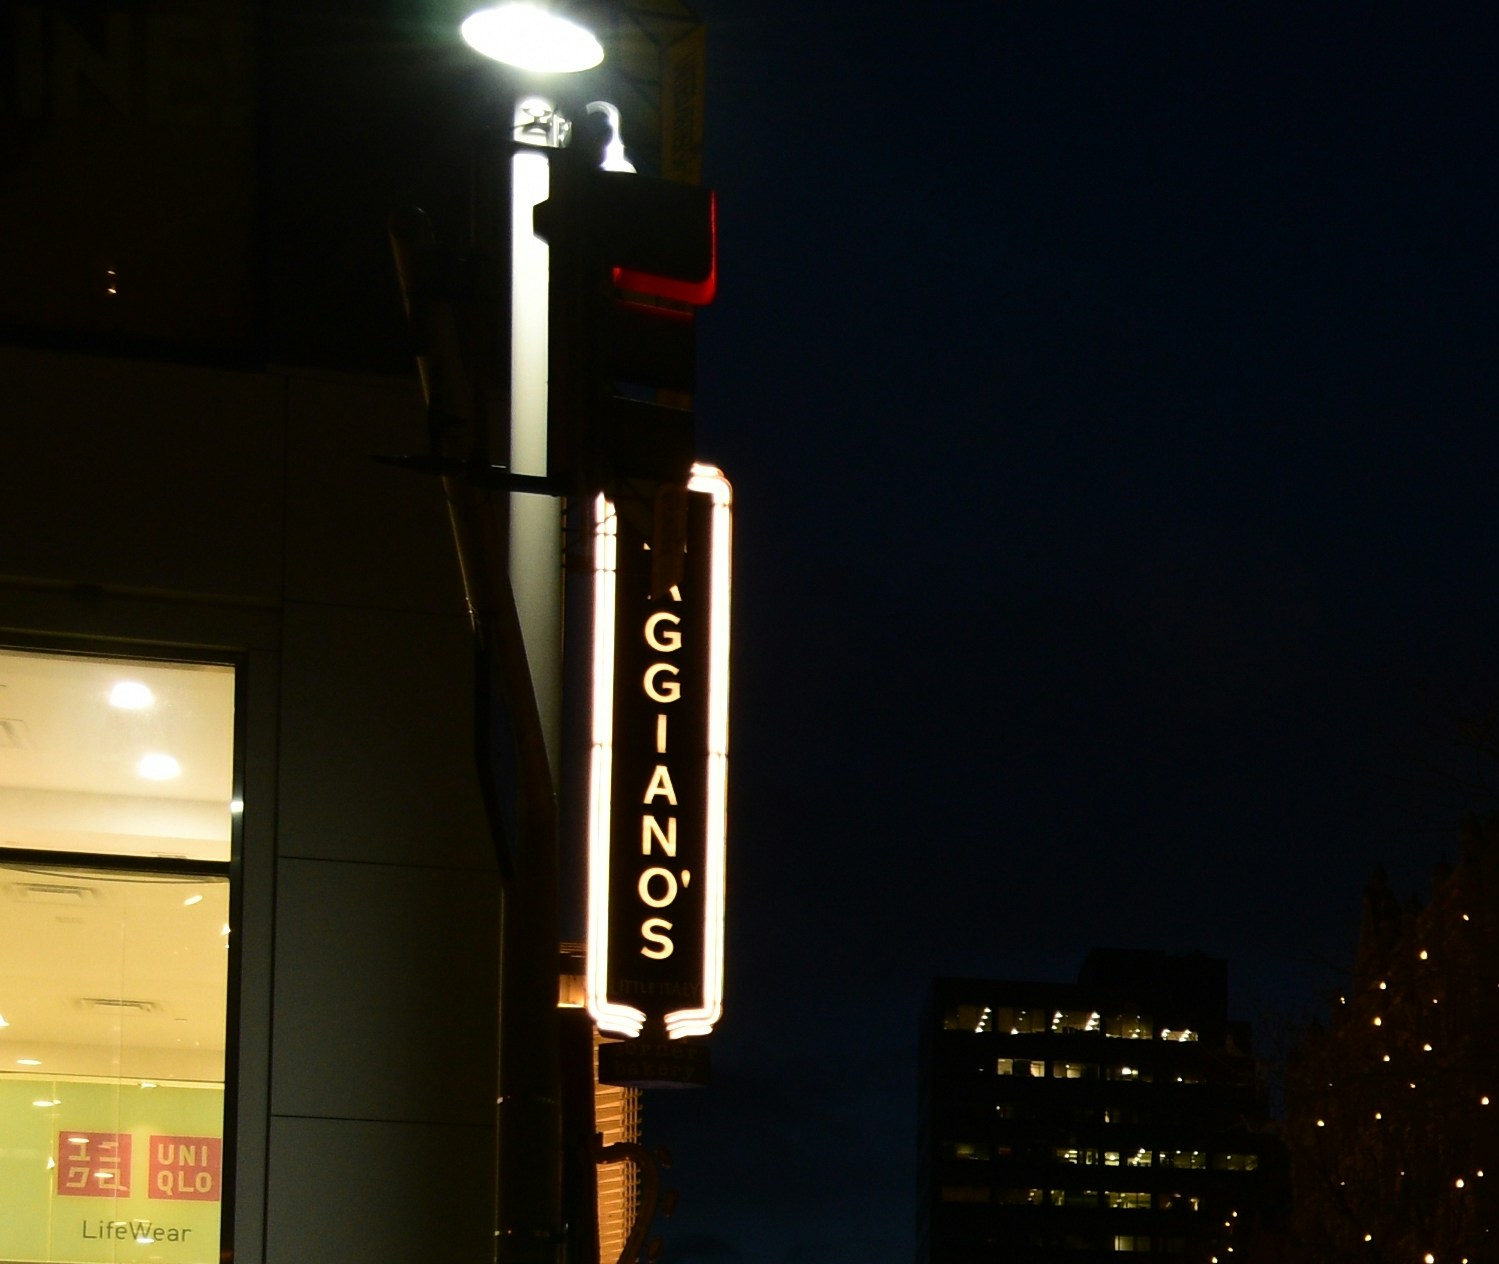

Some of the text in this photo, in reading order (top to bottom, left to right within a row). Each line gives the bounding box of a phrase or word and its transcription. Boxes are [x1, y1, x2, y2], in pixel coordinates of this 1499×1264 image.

[637, 540, 692, 960] GGIANO'S
[614, 1061, 695, 1081] bakery
[158, 1143, 208, 1167] UNI
[157, 1170, 213, 1195] QLO
[82, 1220, 192, 1242] LifeWear
